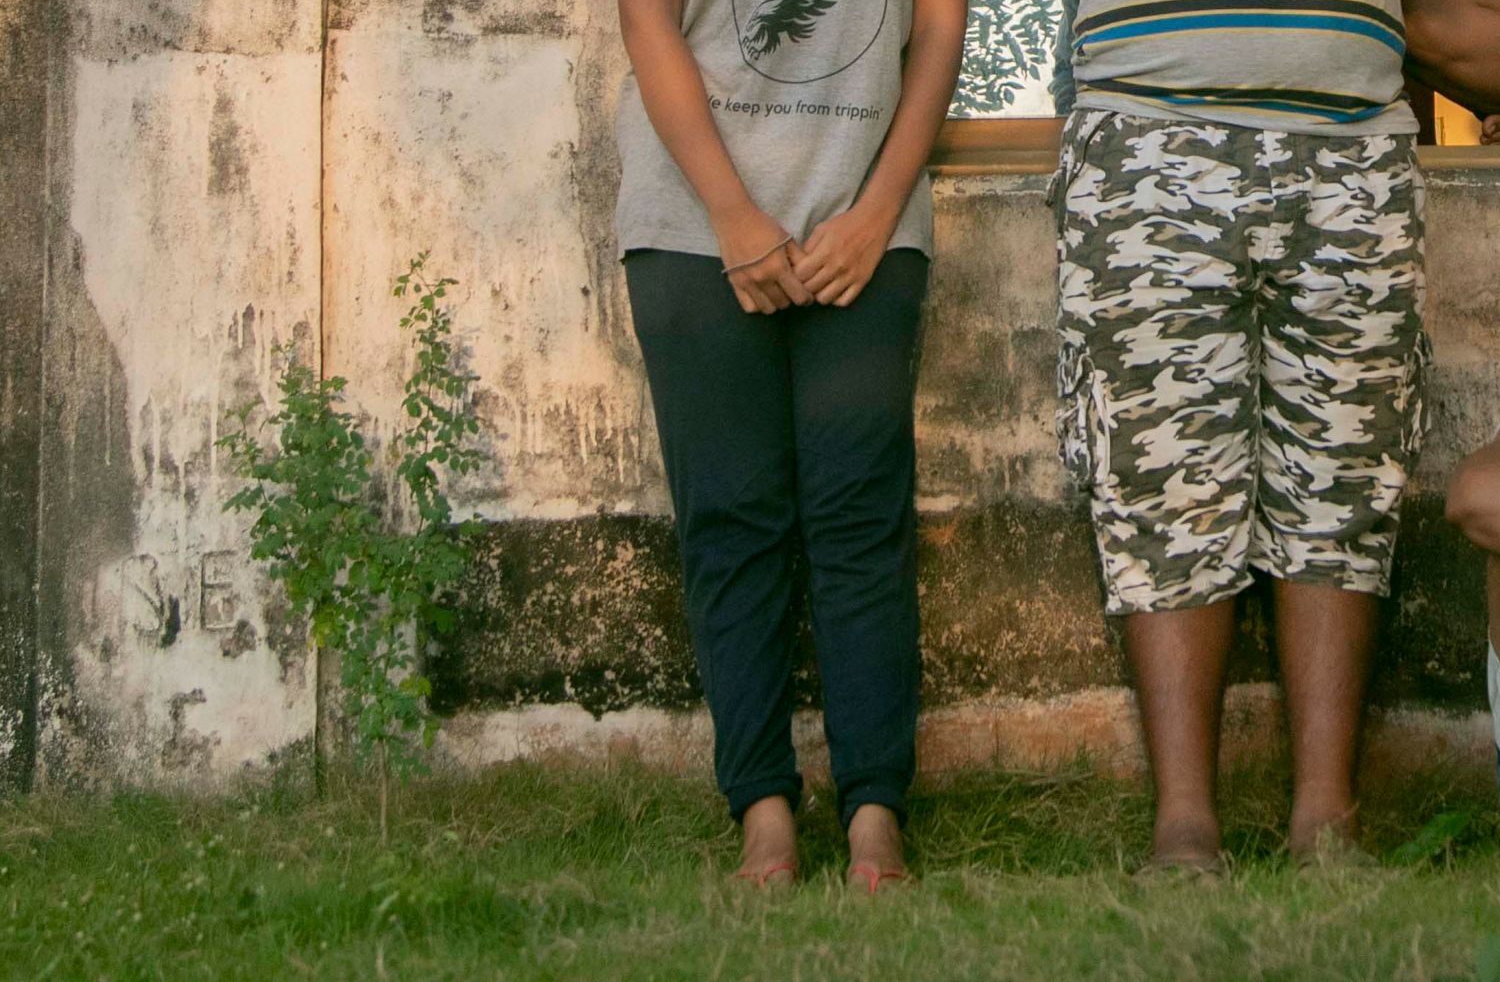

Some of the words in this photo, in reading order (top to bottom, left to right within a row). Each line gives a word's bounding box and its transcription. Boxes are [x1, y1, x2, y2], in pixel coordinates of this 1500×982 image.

[724, 98, 760, 116] keep
[764, 103, 792, 118] you
[796, 99, 831, 116] from
[835, 104, 884, 122] trippin'
